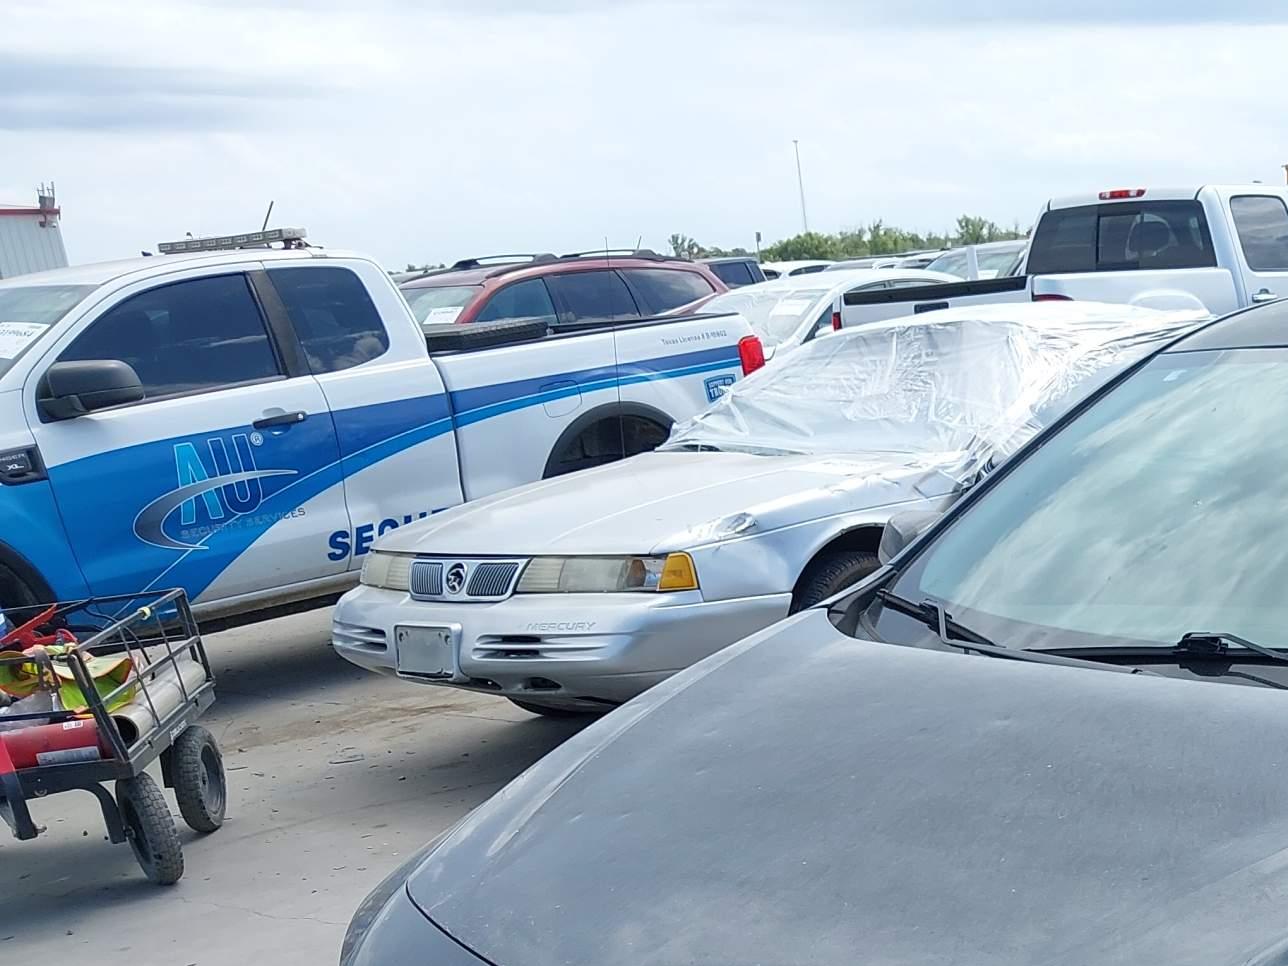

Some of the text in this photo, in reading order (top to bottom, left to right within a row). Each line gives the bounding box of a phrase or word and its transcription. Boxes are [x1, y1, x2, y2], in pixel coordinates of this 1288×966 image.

[179, 507, 307, 539] SECURITY SERVICES
[526, 621, 597, 632] MERCURY
